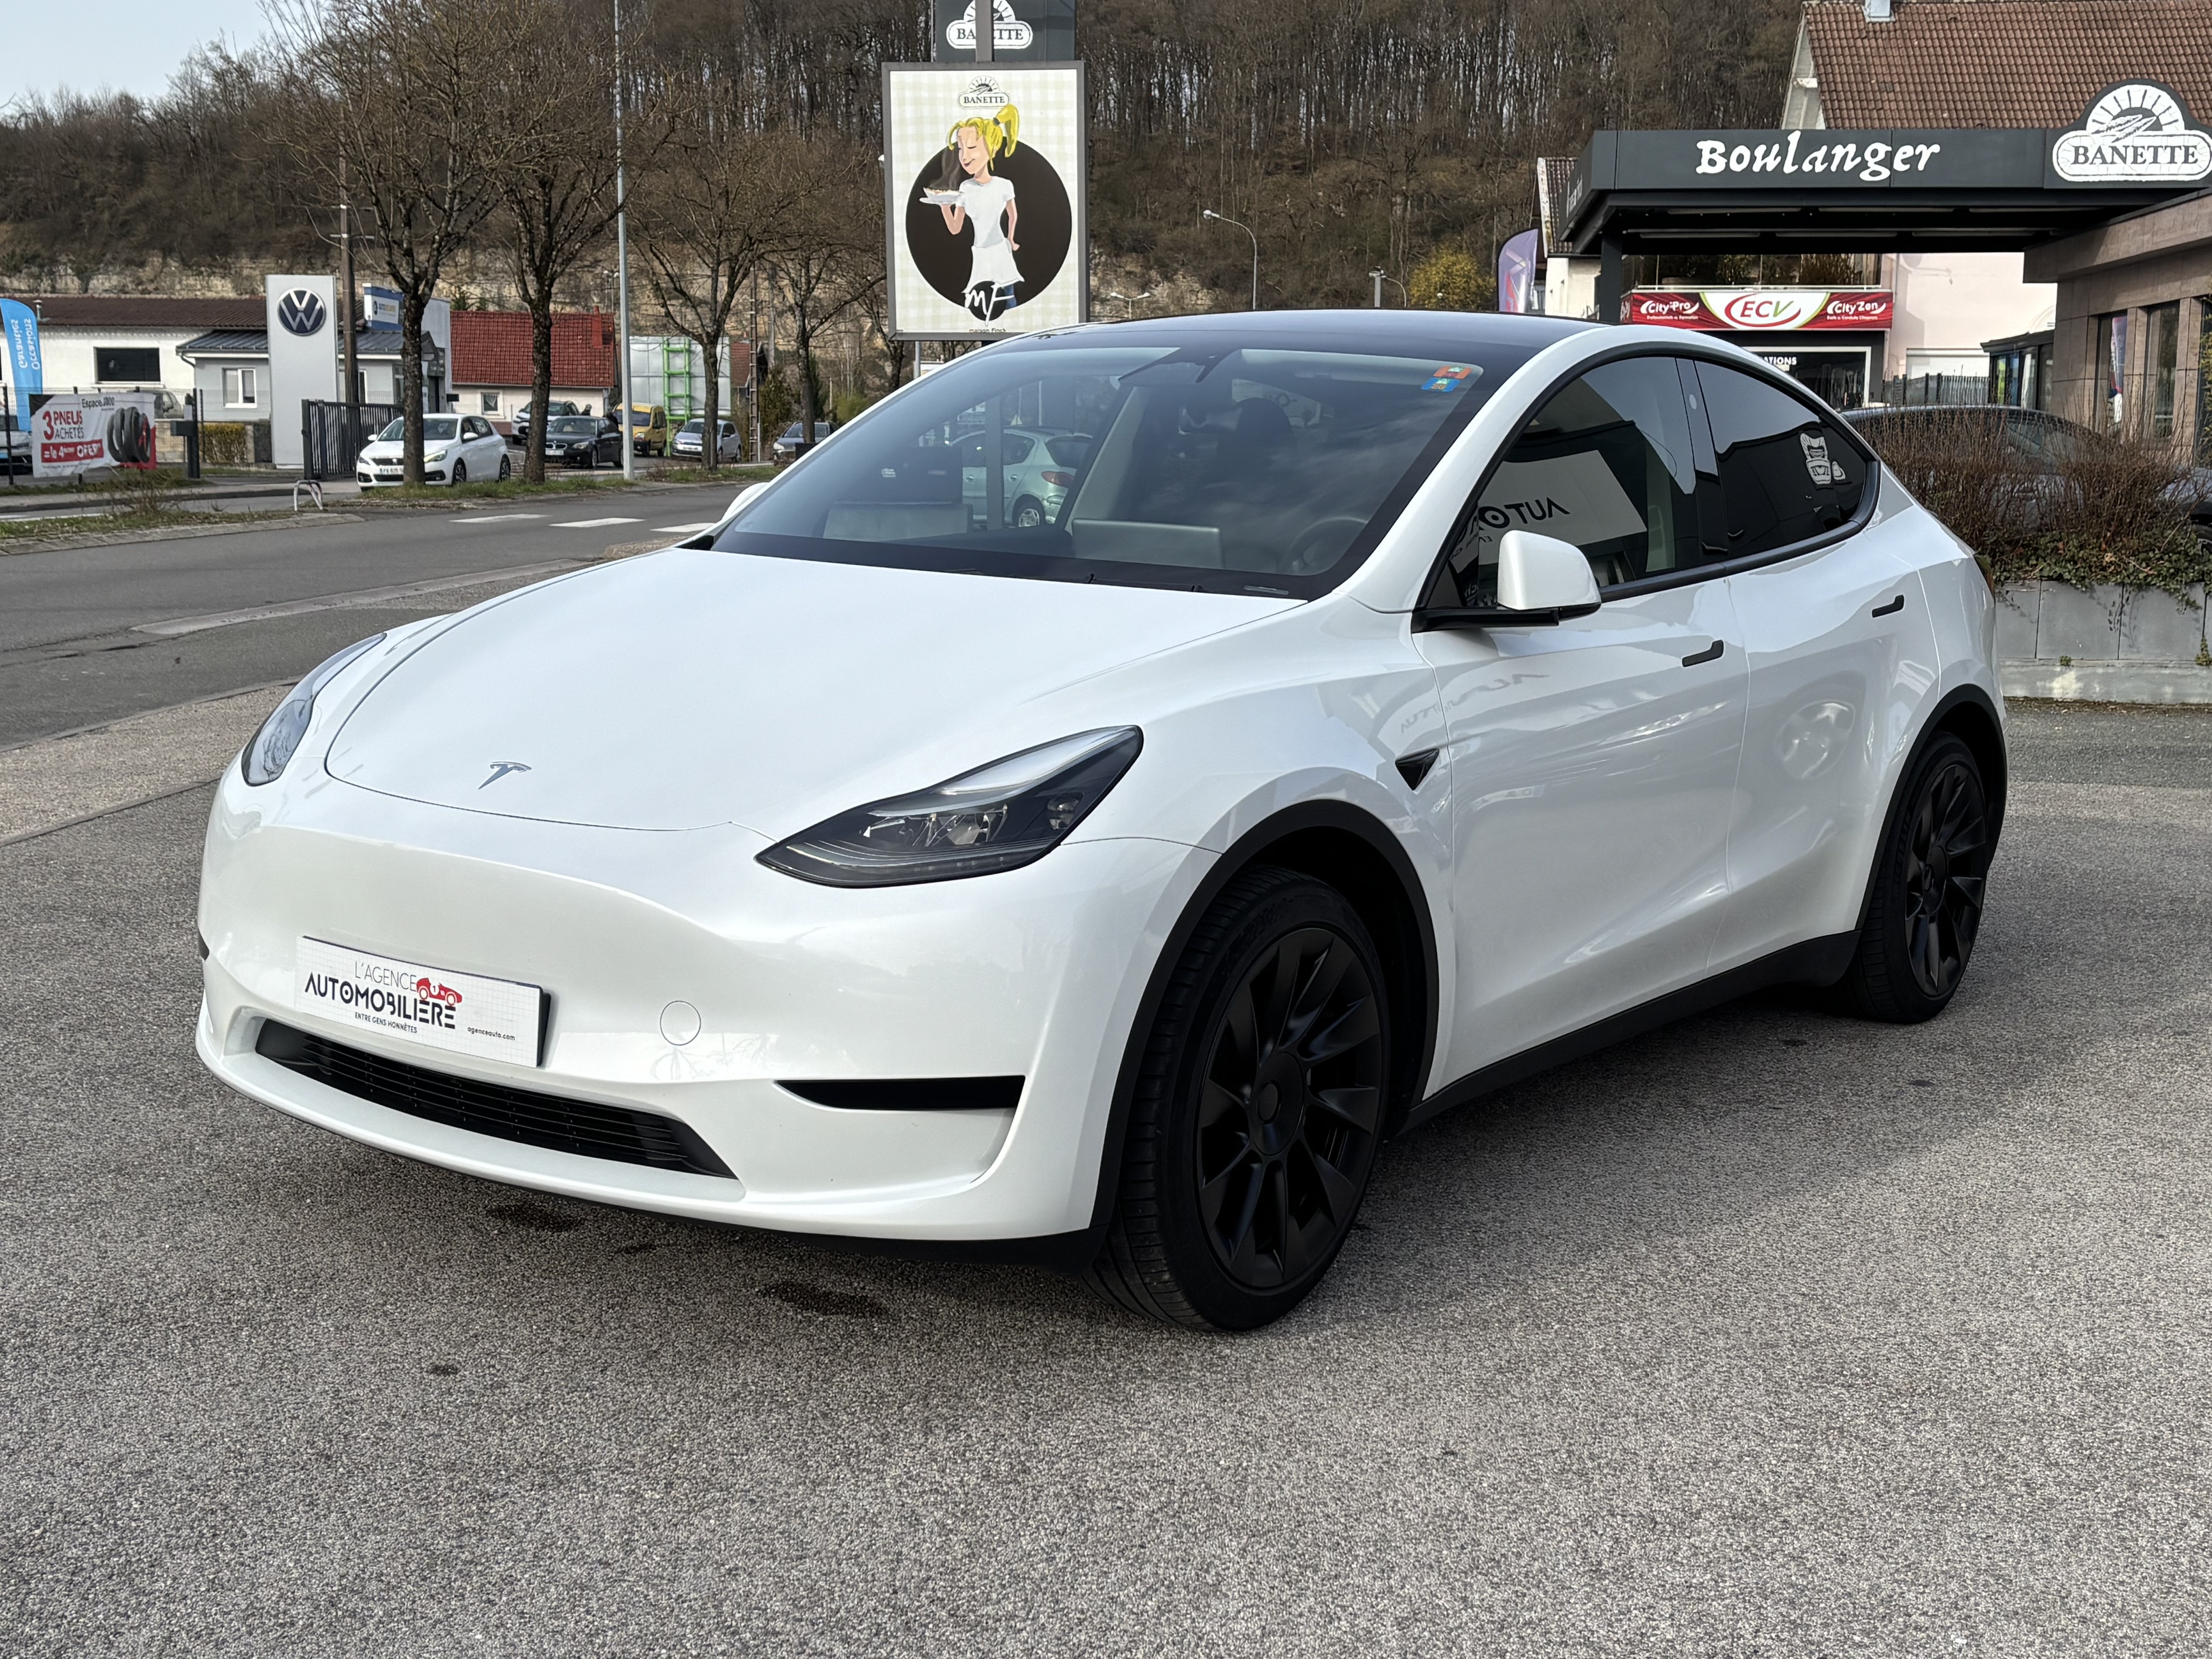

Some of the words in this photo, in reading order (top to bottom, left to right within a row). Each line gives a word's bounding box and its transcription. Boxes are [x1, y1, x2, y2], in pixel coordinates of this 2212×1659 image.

[957, 28, 1024, 40] BATTE
[1696, 131, 1940, 181] Boulanger
[2071, 144, 2198, 165] BANETTE
[1740, 301, 1794, 318] ECV
[43, 410, 54, 440] 3
[53, 410, 82, 426] PNEUS
[355, 961, 417, 991] L'AGENCE
[355, 1012, 371, 1022] ENTRE
[372, 1017, 386, 1026] GENS
[467, 1027, 515, 1041] agenceauto.com
